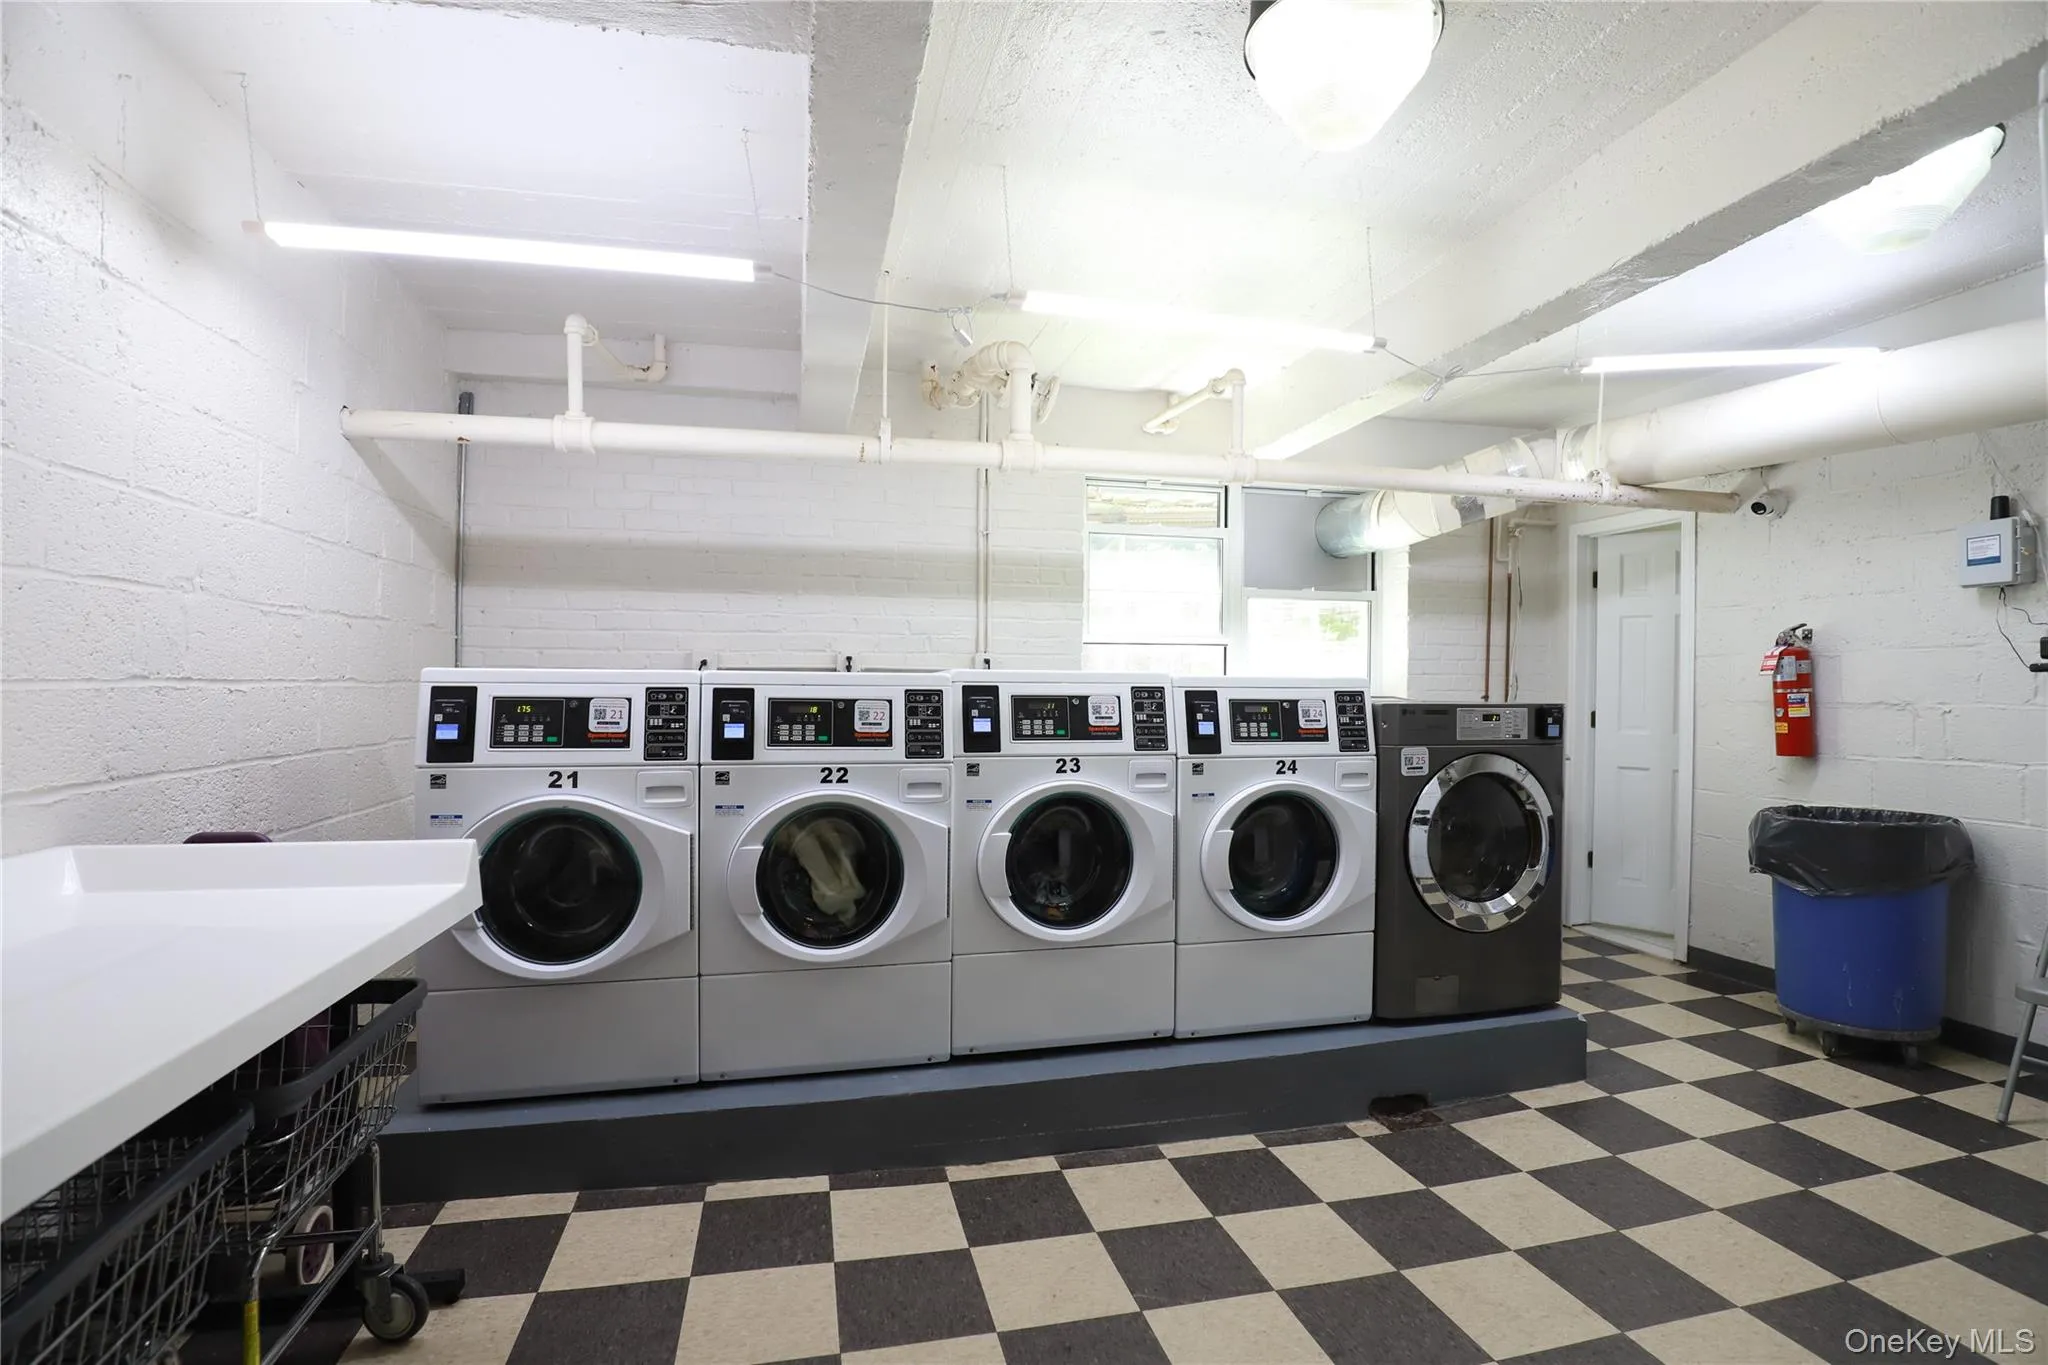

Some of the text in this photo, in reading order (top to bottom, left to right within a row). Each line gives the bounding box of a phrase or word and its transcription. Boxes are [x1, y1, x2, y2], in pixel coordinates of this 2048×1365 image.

[610, 709, 624, 720] 21
[1104, 705, 1116, 715] 23
[1312, 709, 1323, 718] 24
[873, 711, 886, 721] 22
[1055, 757, 1081, 774] 23
[1415, 756, 1426, 765] 25
[1275, 759, 1298, 775] 24
[548, 770, 578, 789] 21
[820, 766, 849, 784] 22
